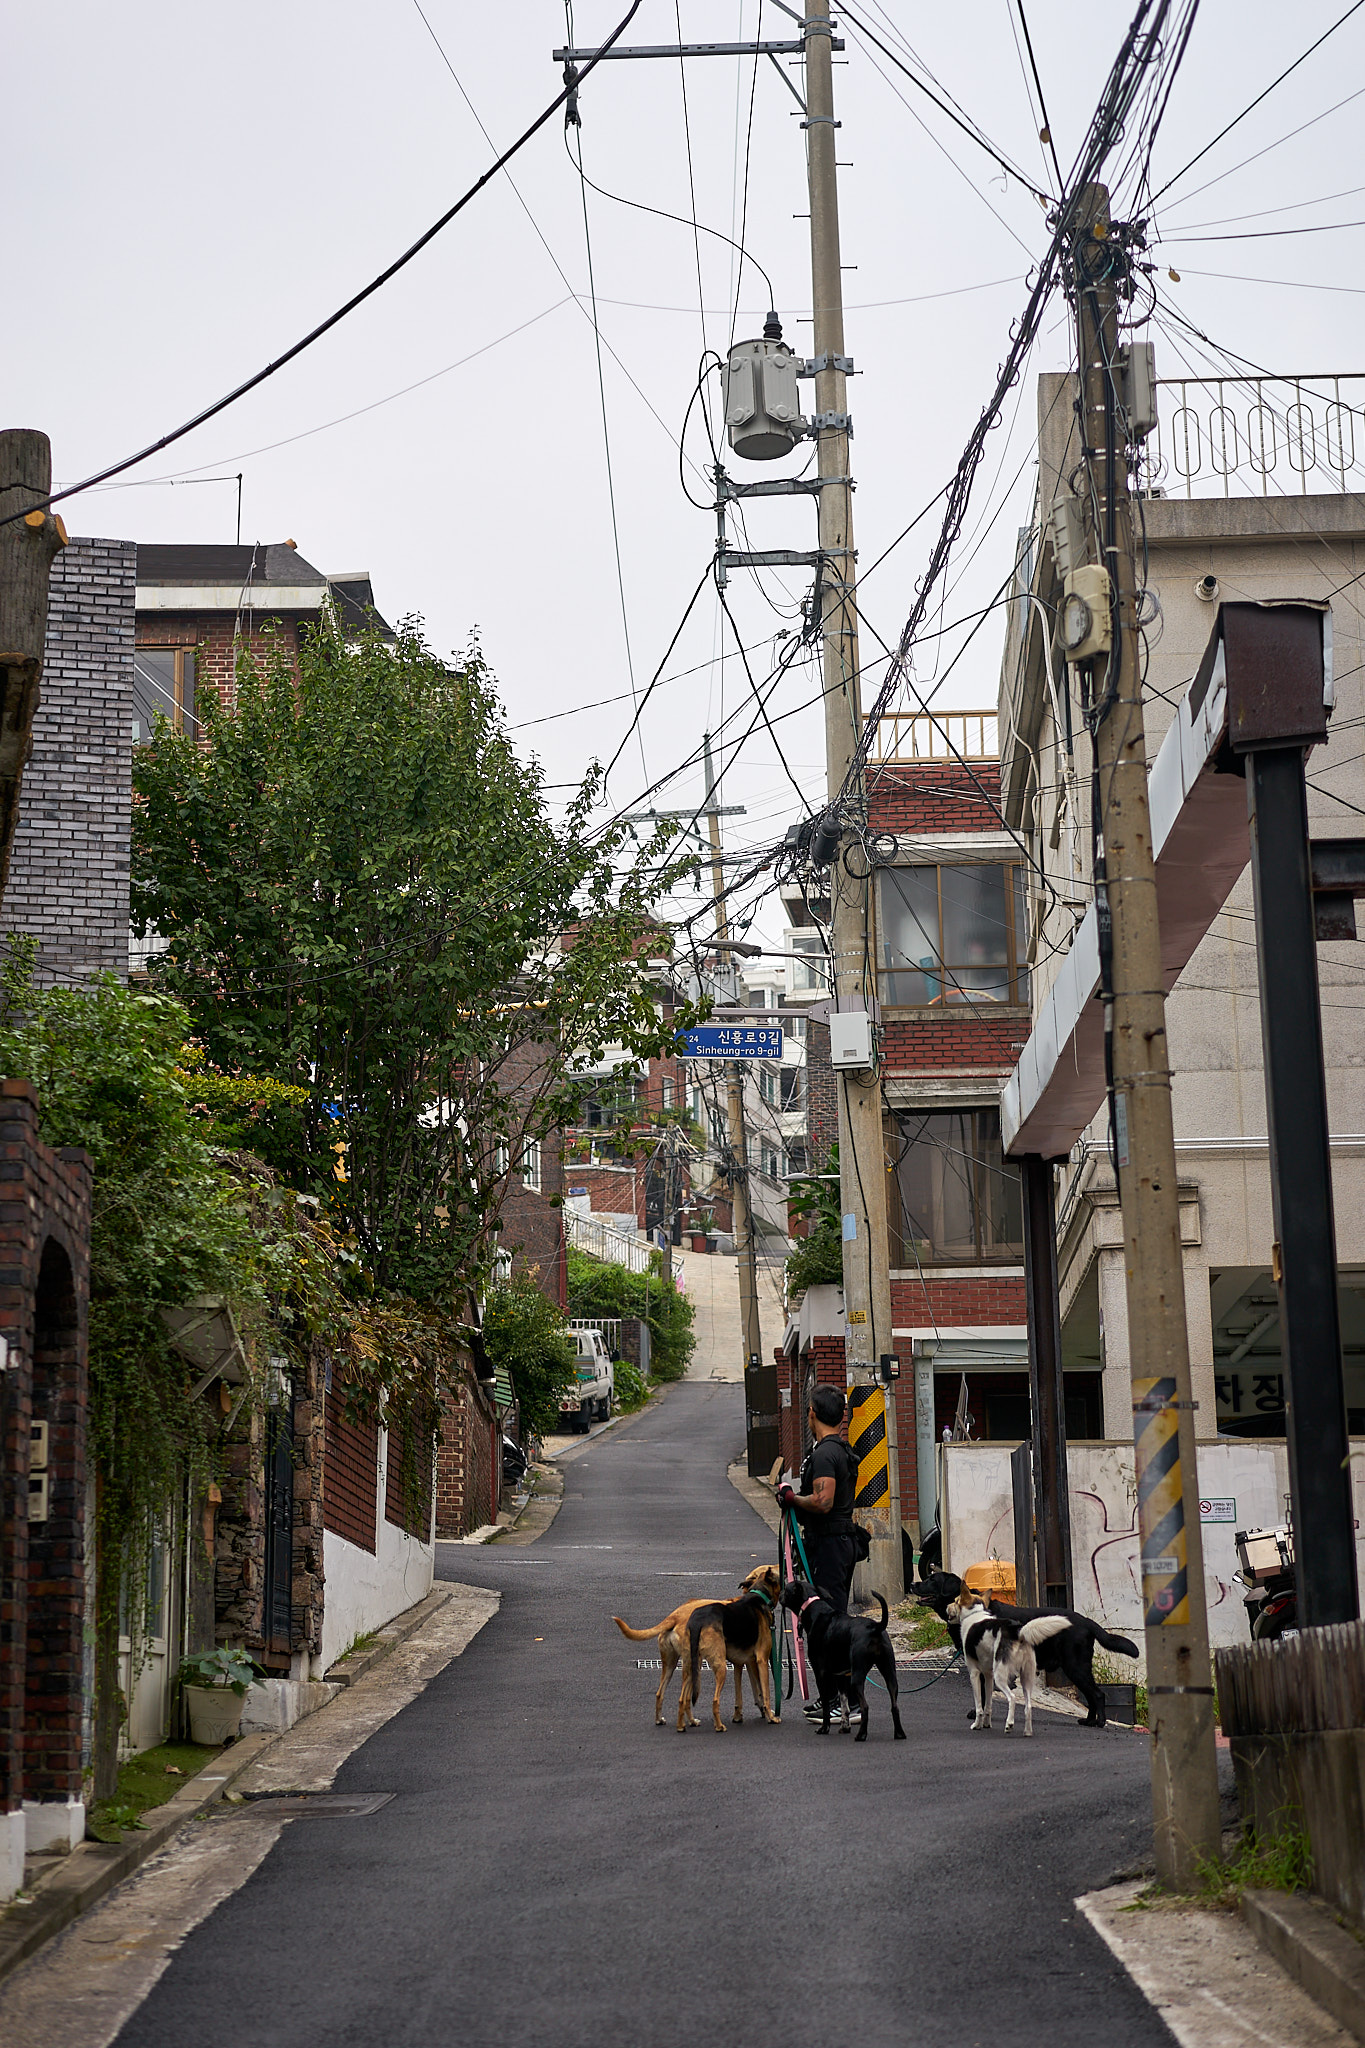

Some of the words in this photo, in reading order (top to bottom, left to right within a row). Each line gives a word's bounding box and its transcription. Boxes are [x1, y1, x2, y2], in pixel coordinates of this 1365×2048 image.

[718, 1030, 779, 1045] 신흥로9길
[696, 1045, 755, 1056] Sinheung-ro
[757, 1046, 779, 1057] 9-gil
